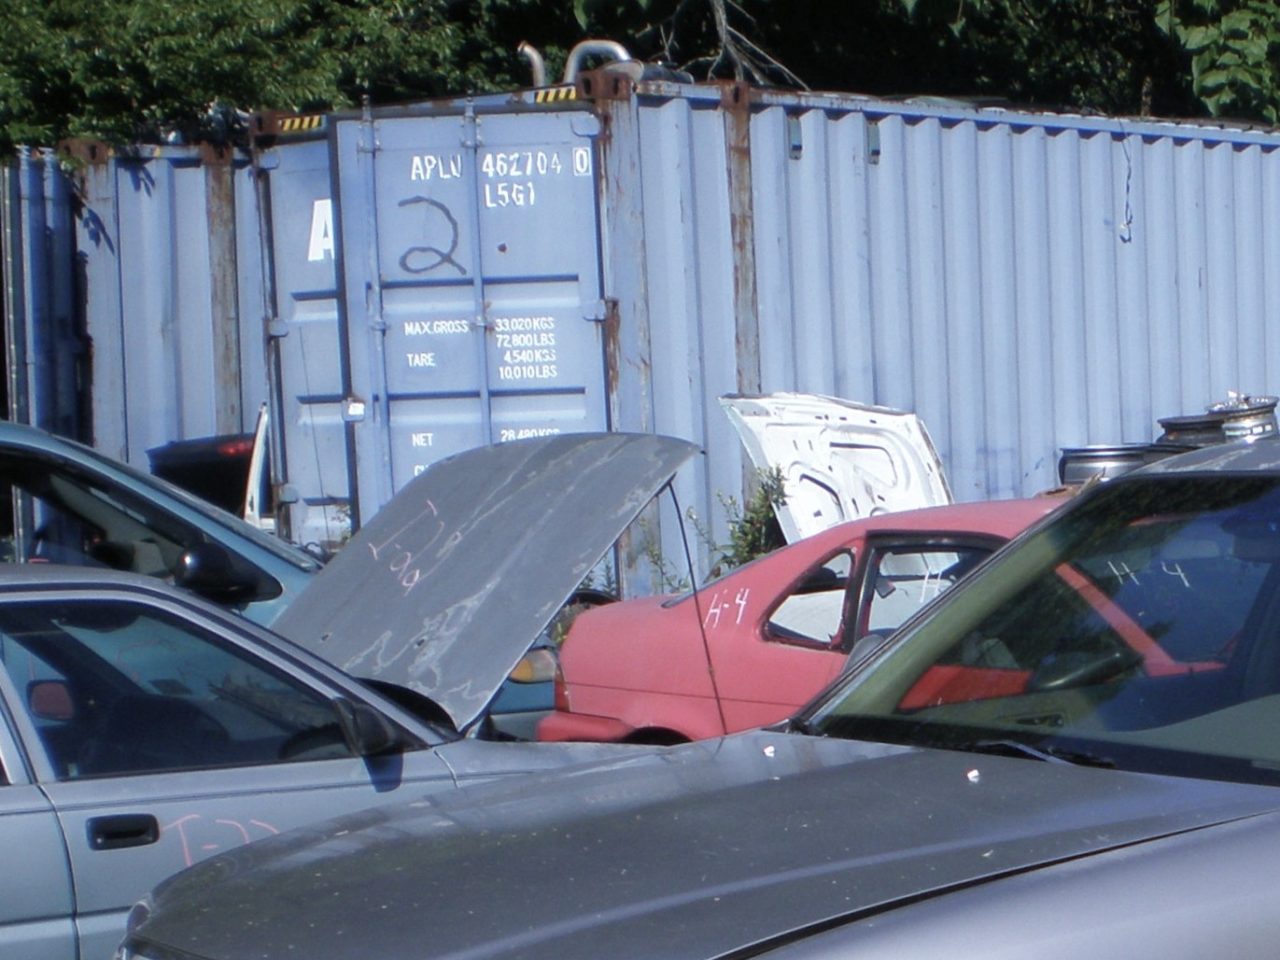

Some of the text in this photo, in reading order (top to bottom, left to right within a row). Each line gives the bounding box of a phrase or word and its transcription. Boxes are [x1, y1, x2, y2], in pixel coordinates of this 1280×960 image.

[482, 150, 562, 178] 462704
[573, 149, 592, 177] 0
[485, 182, 535, 208] L5G1
[308, 199, 335, 261] A
[407, 353, 436, 367] TARE
[412, 433, 433, 447] NET
